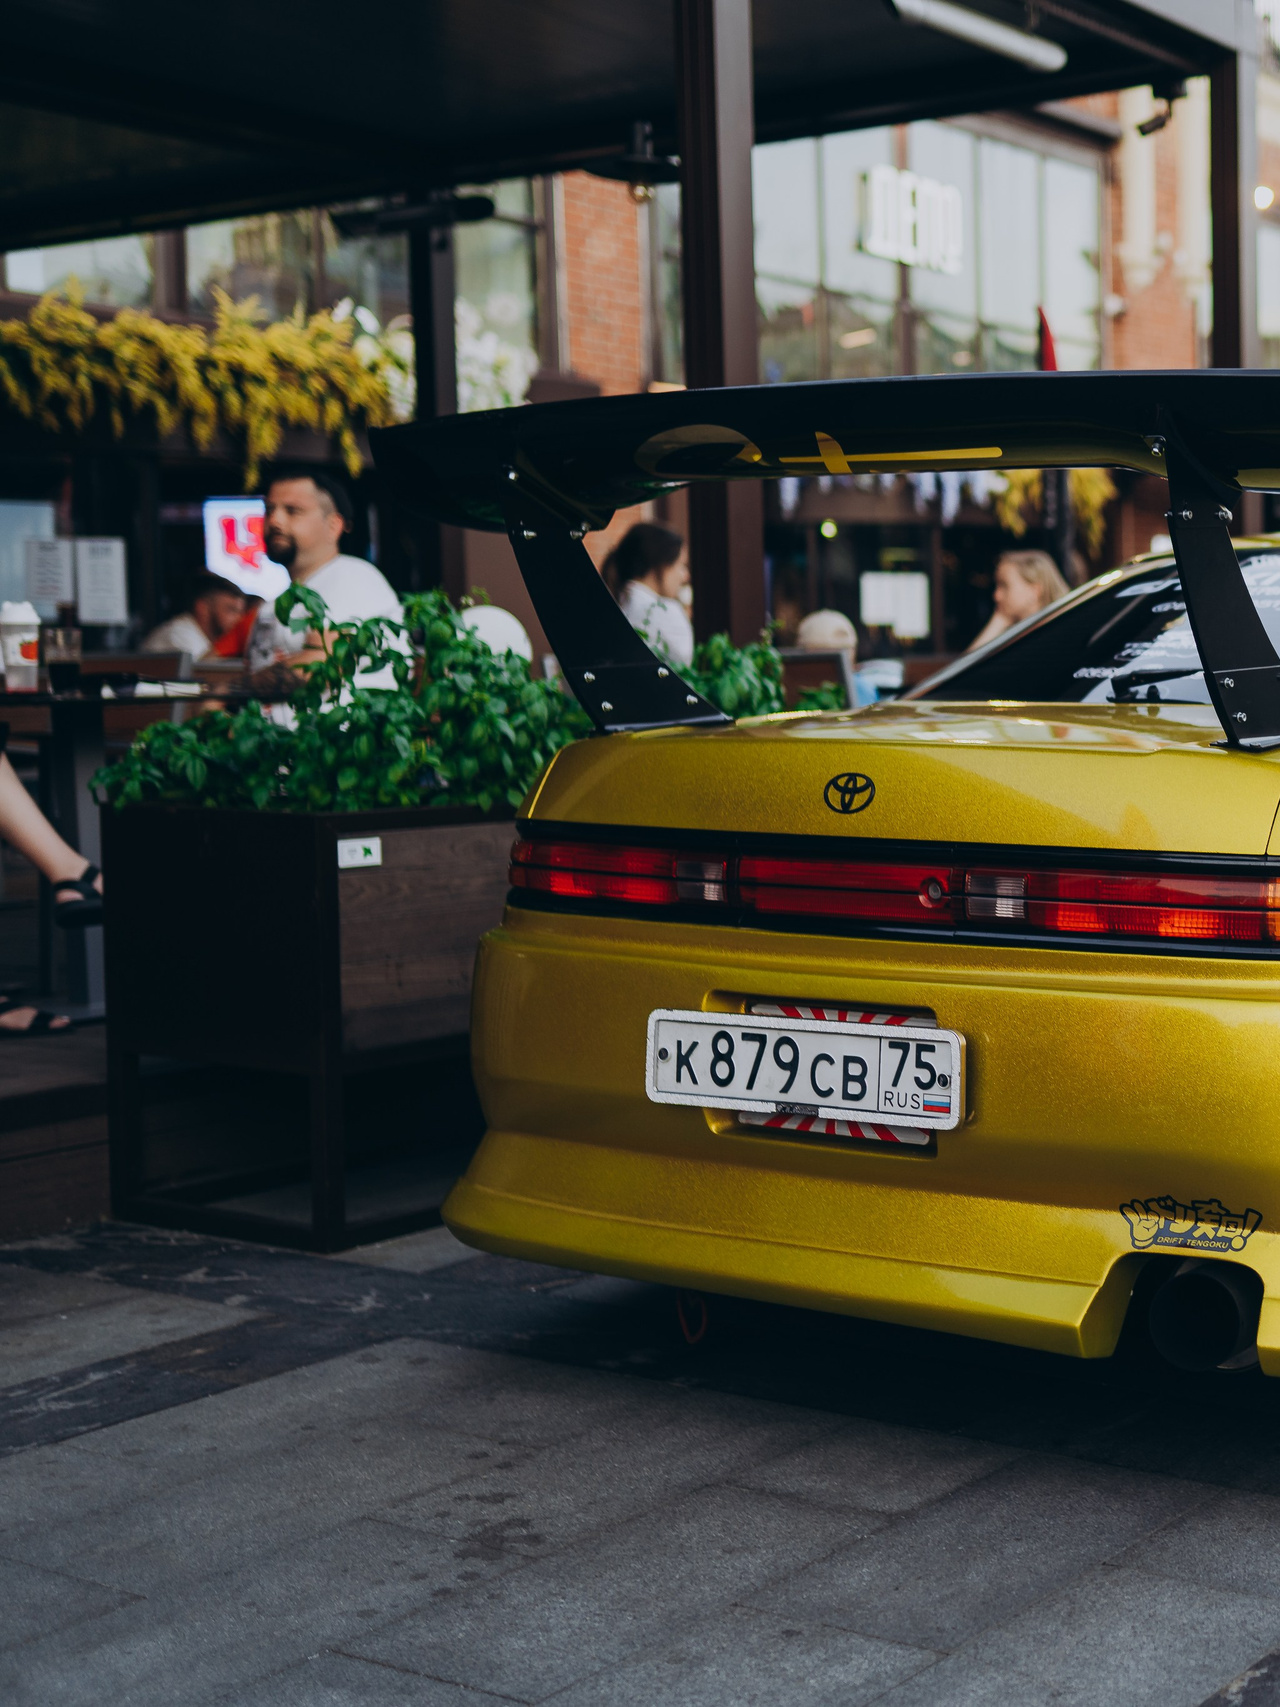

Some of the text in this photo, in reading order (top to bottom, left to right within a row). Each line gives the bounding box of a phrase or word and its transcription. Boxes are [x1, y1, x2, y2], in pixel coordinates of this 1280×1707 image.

[887, 1041, 938, 1091] 75
[883, 1091, 921, 1110] RUS
[1156, 1236, 1229, 1250] DRIFT TENGOKU
